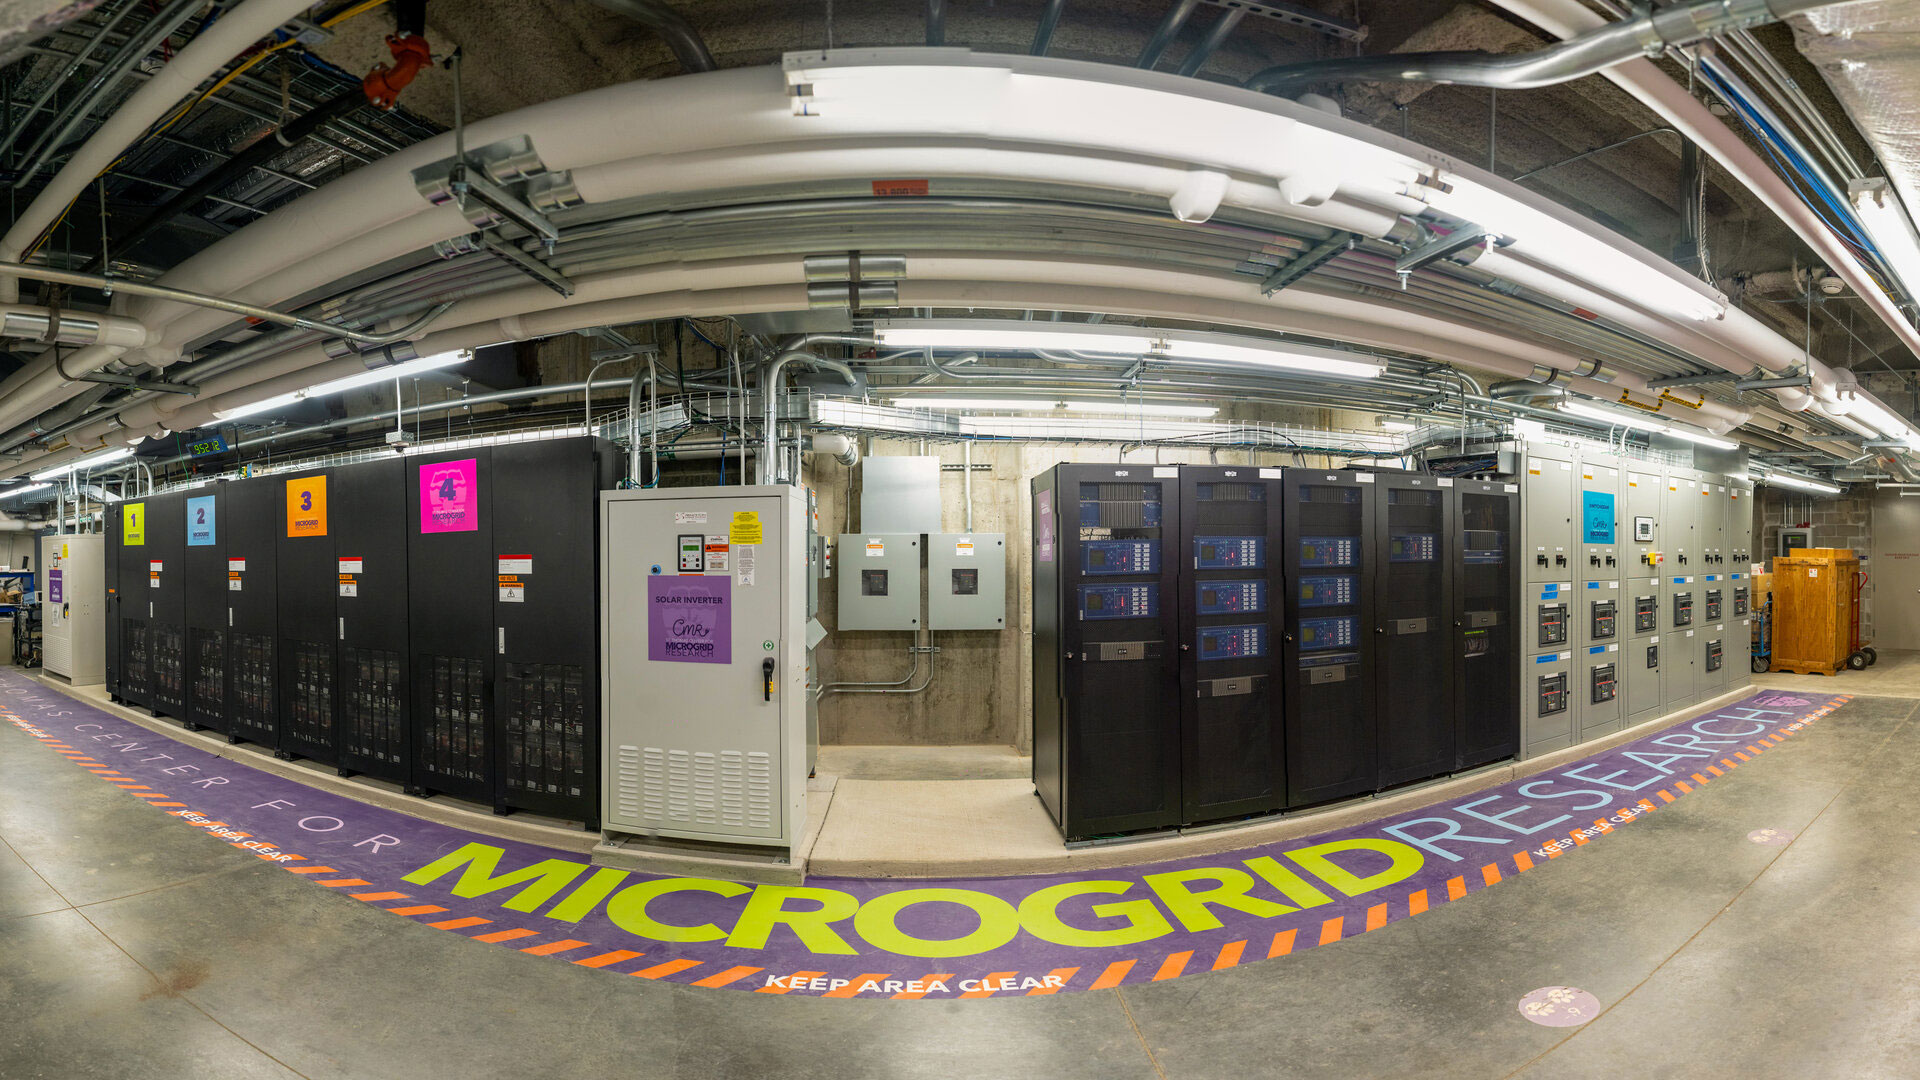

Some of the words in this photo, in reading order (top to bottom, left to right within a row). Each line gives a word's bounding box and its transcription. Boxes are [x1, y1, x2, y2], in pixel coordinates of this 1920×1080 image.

[439, 478, 456, 501] 4
[300, 490, 312, 511] 3
[130, 513, 136, 528] 1
[196, 507, 205, 524] 2
[432, 511, 466, 521] MICROGRID
[655, 596, 682, 604] SOLAR
[683, 596, 723, 604] INVERTER
[665, 641, 714, 651] MICROGRID
[665, 649, 714, 658] RESEARCH
[0, 679, 73, 717] HOMAS
[74, 723, 230, 789] CENTER
[250, 799, 401, 854] FOR
[400, 838, 1424, 958] MICROGRID
[1380, 706, 1795, 862] RESEARCH
[176, 809, 211, 825] KEEP
[207, 823, 245, 842] AREA
[242, 840, 293, 863] CLEAR
[1533, 838, 1575, 857] KEEP
[1574, 821, 1616, 840] AREA
[1610, 803, 1653, 822] CLEAR
[764, 974, 850, 991] KEEP
[856, 979, 951, 993] AREA
[958, 975, 1067, 992] CLEAR
